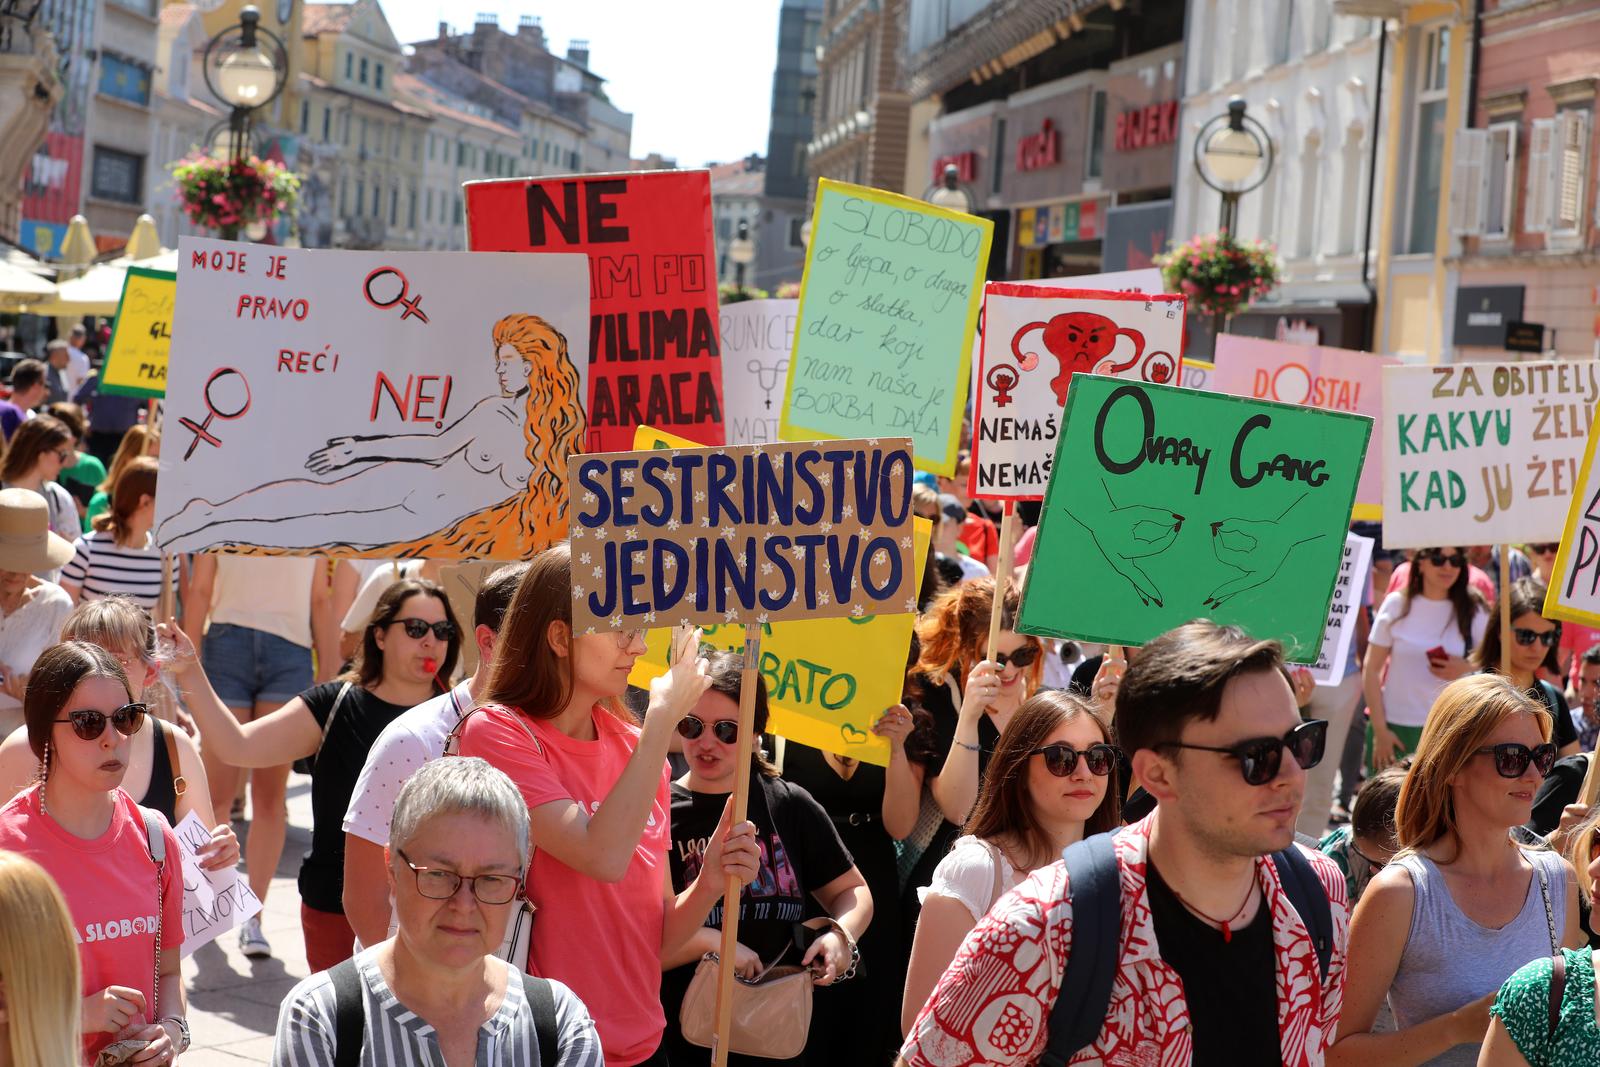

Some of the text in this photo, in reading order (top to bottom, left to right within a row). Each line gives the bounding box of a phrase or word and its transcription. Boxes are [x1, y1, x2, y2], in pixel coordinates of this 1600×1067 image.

[526, 178, 630, 247] NE
[191, 250, 289, 280] MOJE JE
[653, 253, 706, 295] PO
[236, 294, 309, 321] PRAVO
[808, 315, 864, 343] dar
[277, 344, 340, 373] REĆI
[803, 356, 853, 386] nam
[1431, 366, 1484, 398] ZA
[369, 370, 454, 430] NE!
[591, 371, 723, 427] ARACA
[1253, 362, 1361, 412] DOSTA!
[788, 386, 940, 437] BORBA DALA
[979, 413, 1057, 443] NEMAŠ
[1398, 408, 1511, 455] KAKVU
[577, 449, 914, 528] SESTRINSTVO
[1400, 469, 1466, 513] KAD
[1473, 463, 1513, 523] JU
[588, 534, 903, 617] JEDINSTVO
[1565, 525, 1600, 599] P
